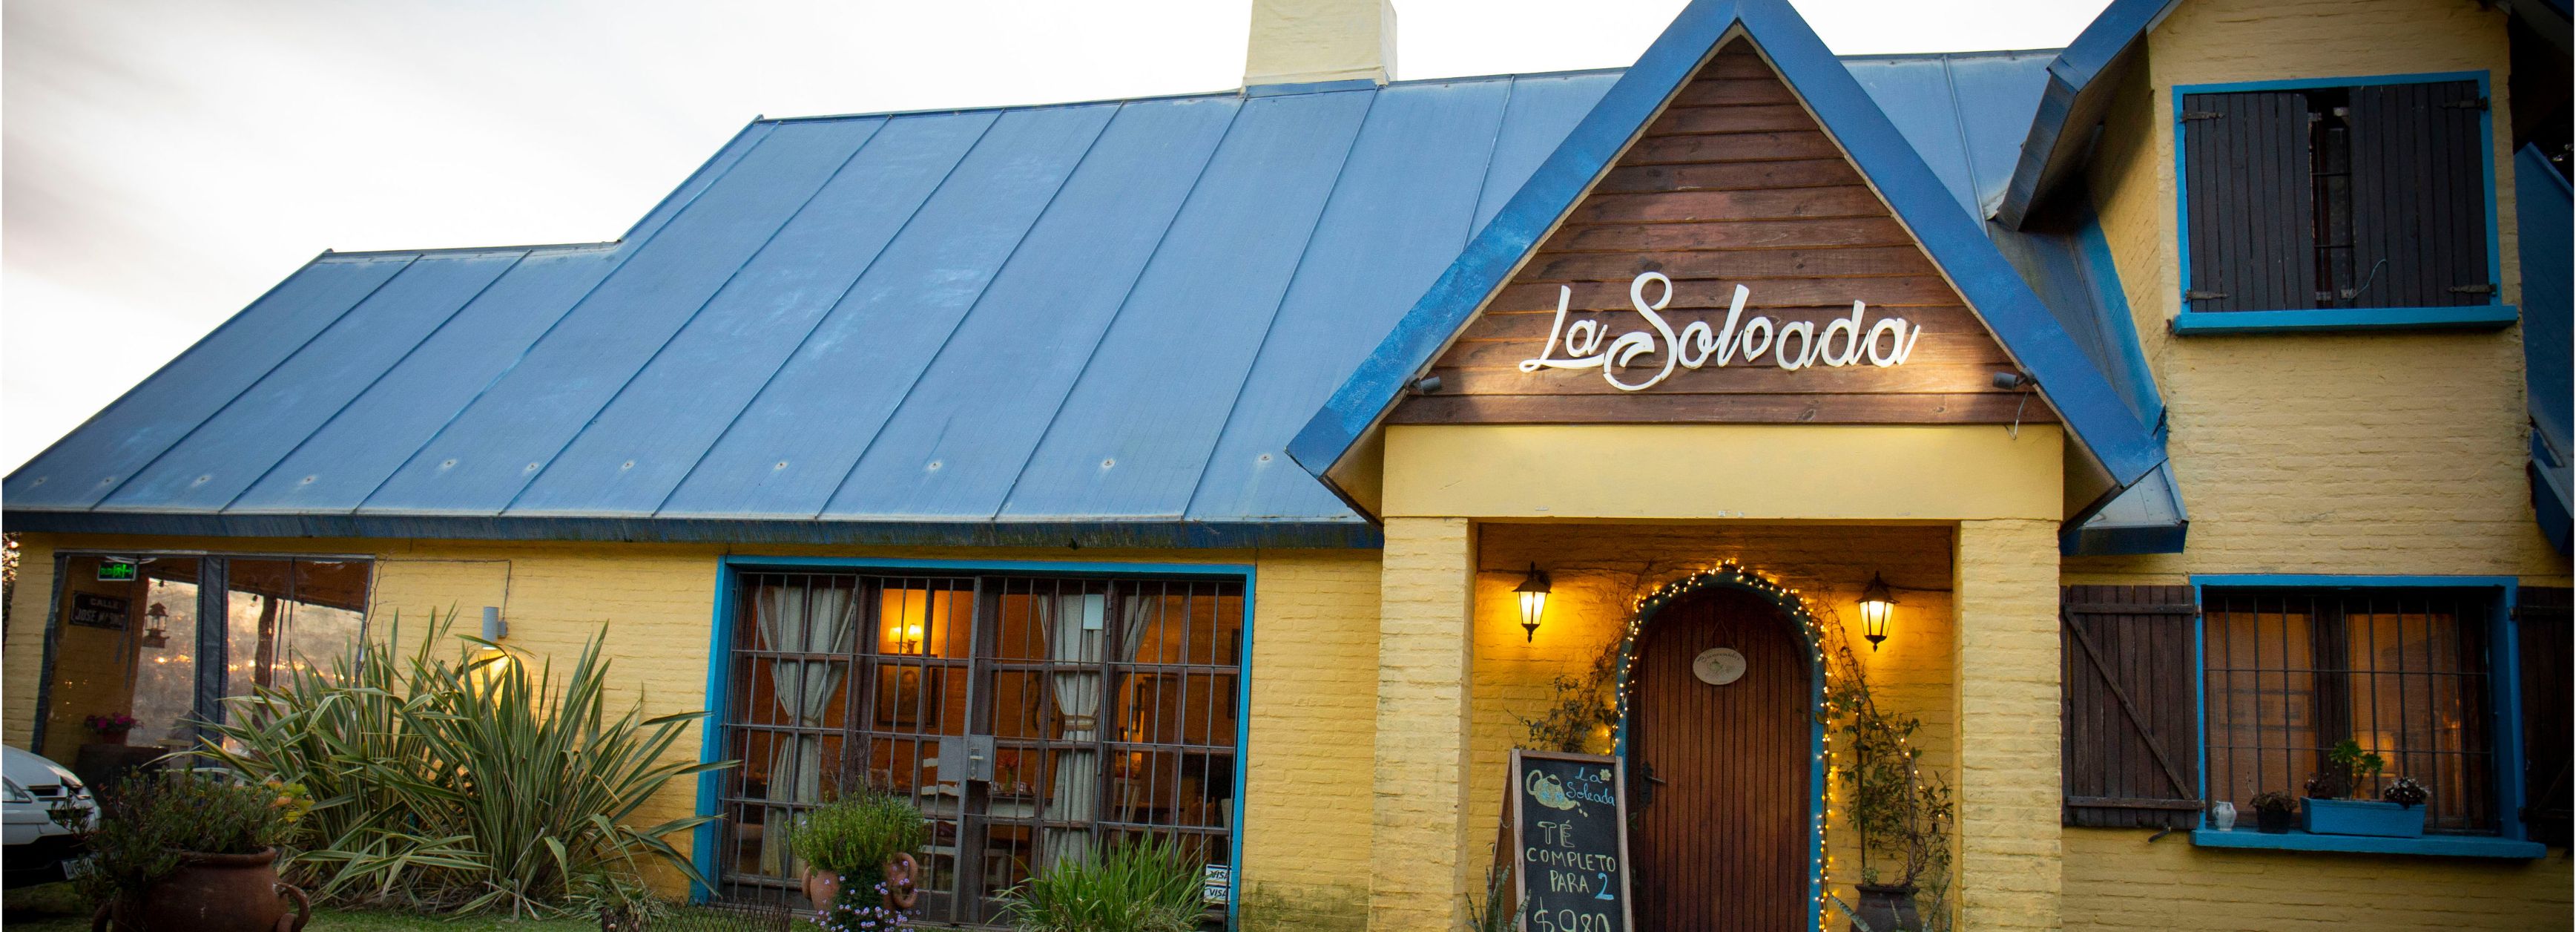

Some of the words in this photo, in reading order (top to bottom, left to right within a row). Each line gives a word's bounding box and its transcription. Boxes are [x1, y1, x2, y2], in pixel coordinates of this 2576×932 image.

[1518, 284, 1607, 373] La
[90, 597, 119, 609] CALLE
[1575, 767, 1602, 784] La
[1566, 781, 1615, 807] Soleada
[1538, 819, 1575, 847] TÉ
[1526, 847, 1615, 872] COMPLETO
[1549, 870, 1590, 893] PARA
[1595, 873, 1614, 900] 2
